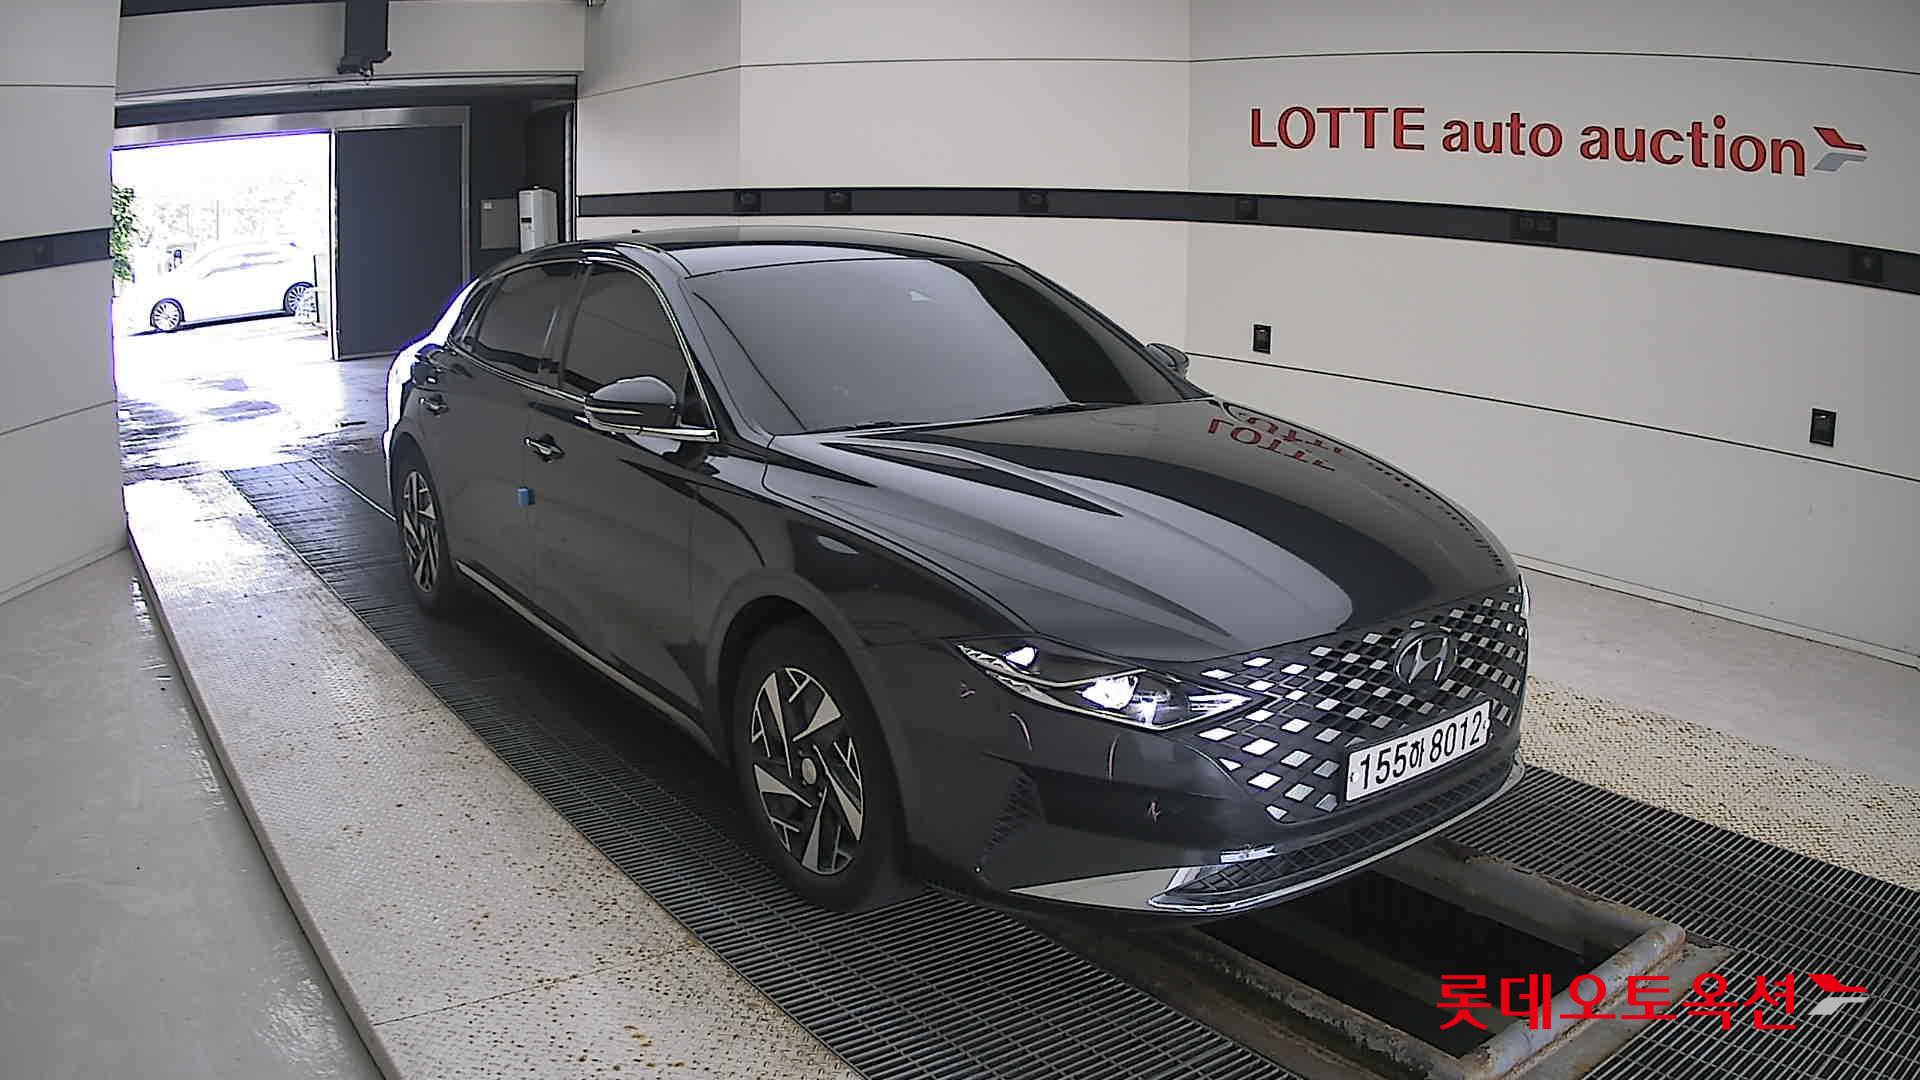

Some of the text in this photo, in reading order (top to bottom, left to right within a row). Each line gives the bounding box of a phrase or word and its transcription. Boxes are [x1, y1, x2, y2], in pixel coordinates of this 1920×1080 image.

[1251, 106, 1806, 177] LOTTE auto auction
